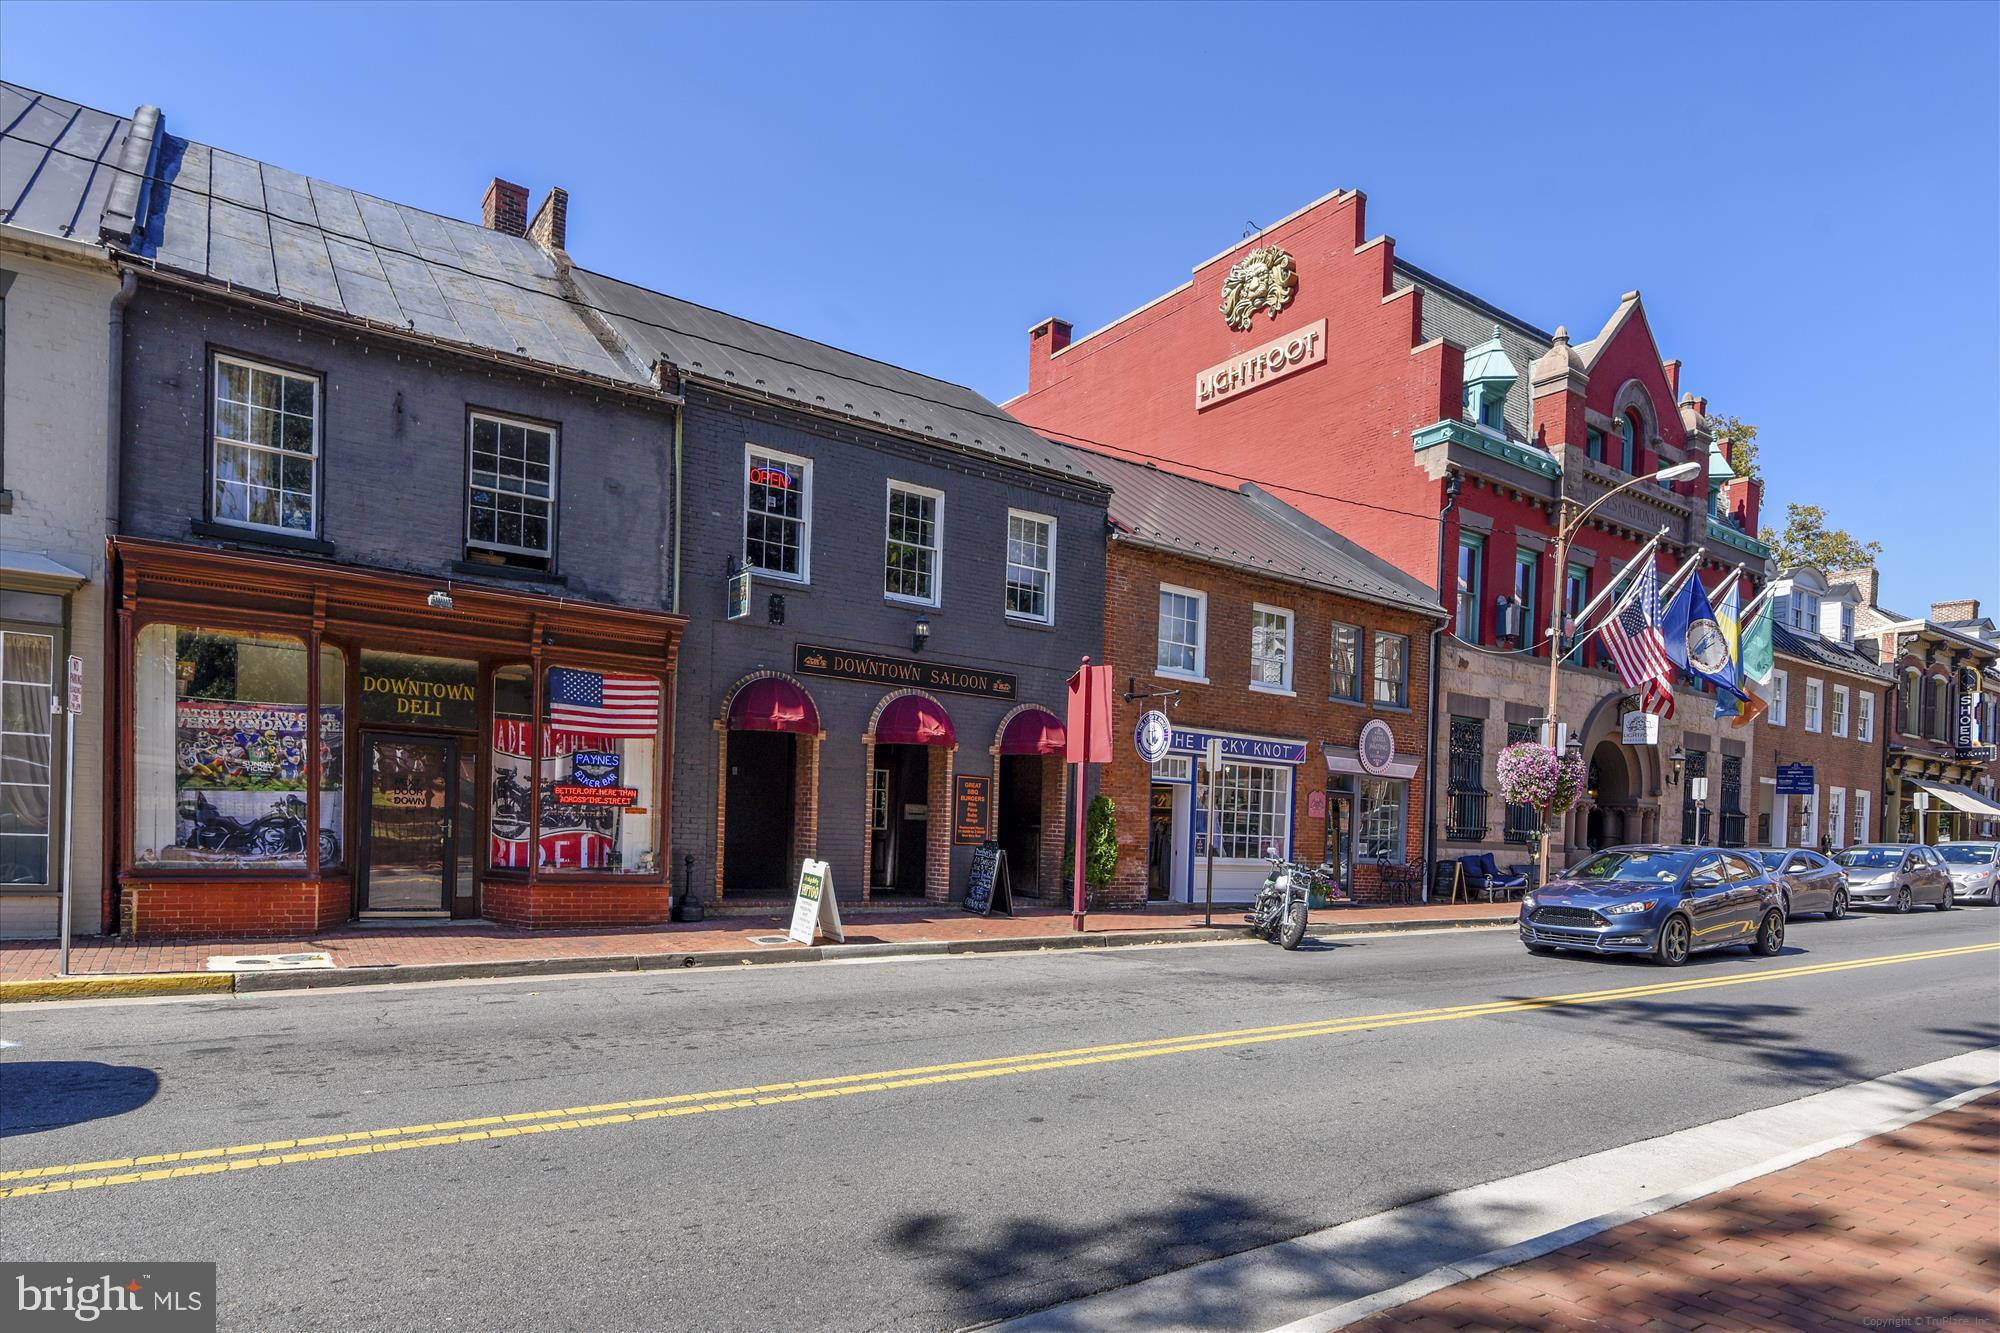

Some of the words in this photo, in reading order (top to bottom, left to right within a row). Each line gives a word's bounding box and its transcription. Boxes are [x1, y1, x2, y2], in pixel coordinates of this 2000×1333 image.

[1197, 330, 1319, 401] LIGHTFOOT
[751, 469, 788, 488] OPEN
[1622, 500, 1658, 525] NATIONAL
[834, 656, 921, 680] DOWNTOWN
[930, 671, 988, 689] SALOON
[363, 676, 475, 701] DOWNTOWN
[222, 710, 266, 720] EVERY
[265, 711, 296, 721] LIVE
[298, 713, 336, 721] GME
[397, 698, 441, 716] DELI
[223, 718, 295, 731] SUNDAY
[298, 720, 341, 732] HRE
[1960, 695, 1972, 745] SHOES
[1170, 733, 1194, 748] HE
[1202, 736, 1247, 754] LCKY
[1254, 742, 1290, 758] KNOT
[576, 754, 619, 766] PAYNES
[574, 770, 600, 788] BIKER
[602, 773, 618, 786] BAR
[394, 788, 423, 796] DOOR
[555, 787, 581, 795] BETTER
[599, 788, 617, 796] HERE
[394, 797, 425, 805] DOWN
